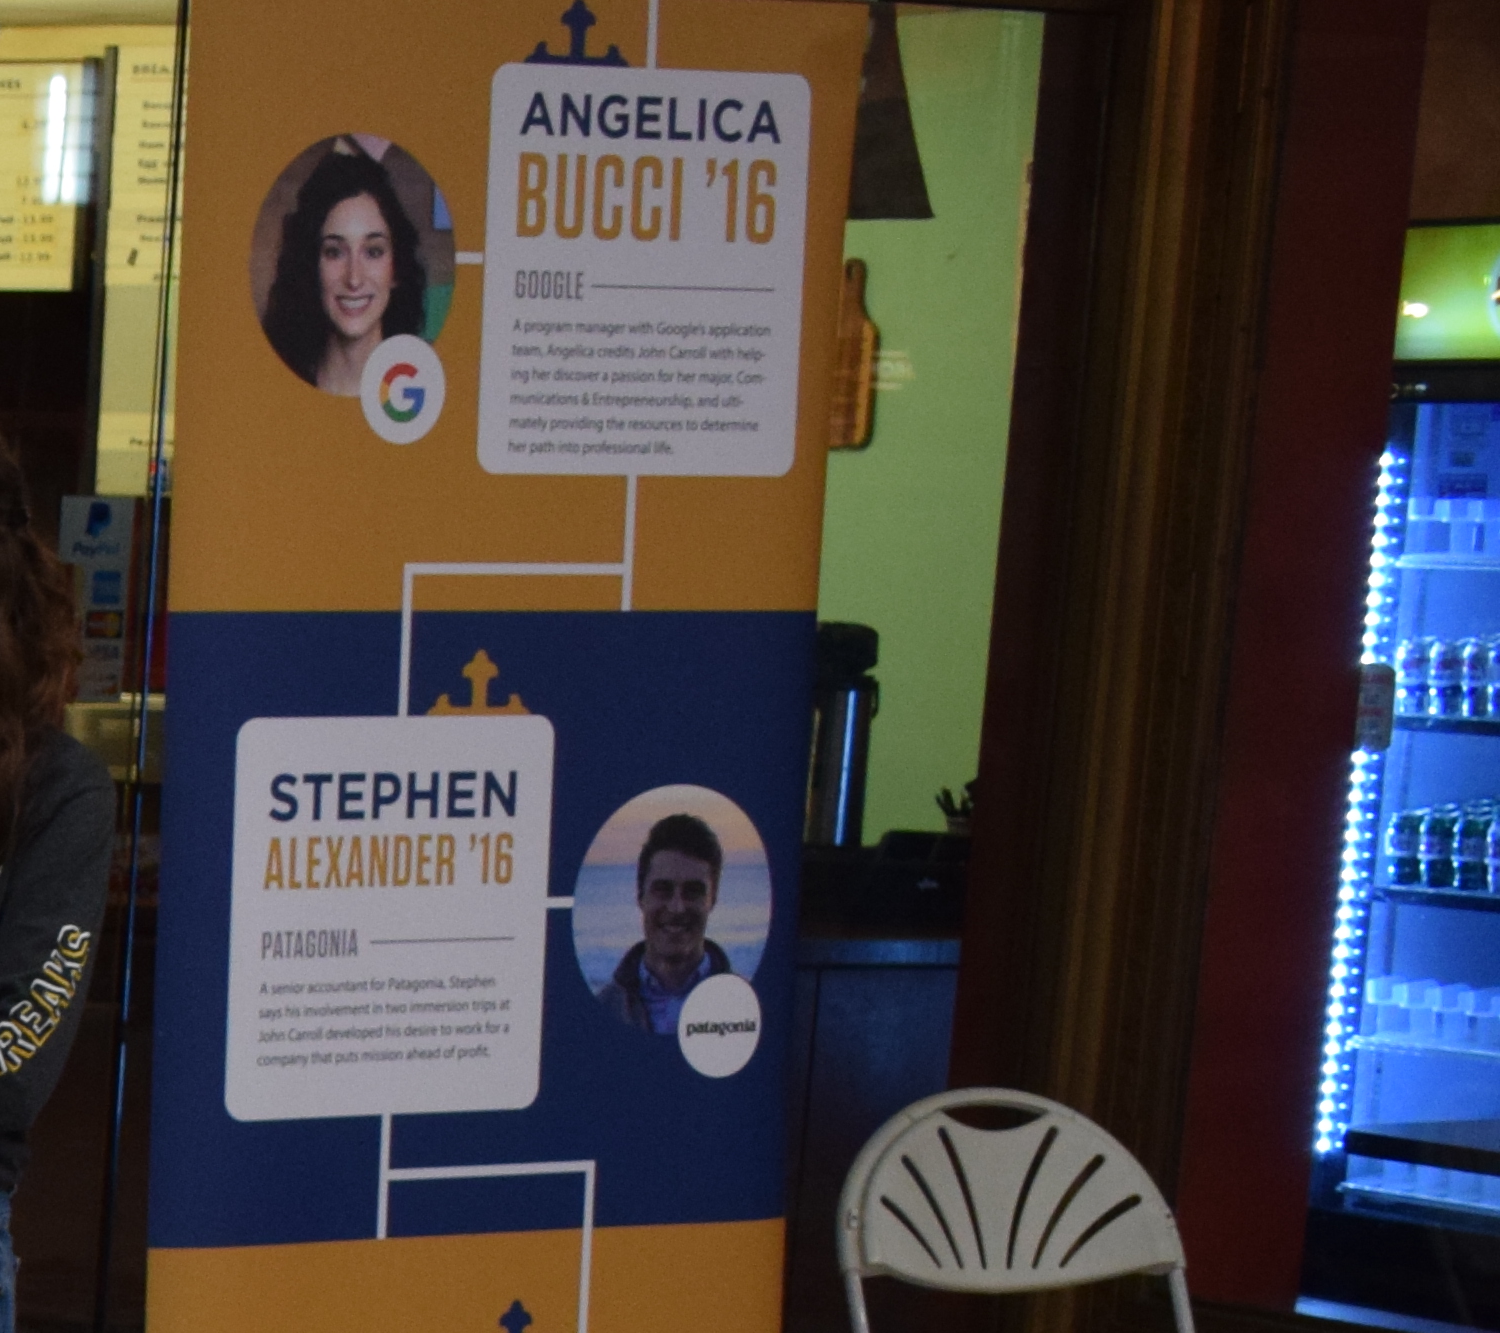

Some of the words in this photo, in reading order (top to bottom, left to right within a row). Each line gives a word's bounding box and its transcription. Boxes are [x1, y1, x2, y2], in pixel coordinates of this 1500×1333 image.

[520, 92, 781, 144] ANGELICA
[515, 152, 684, 242] BUCCI
[706, 157, 778, 245] '16
[515, 270, 585, 300] GOOGLE
[269, 770, 517, 821] STEPHEN
[263, 835, 455, 891] ALEXANDER
[469, 832, 514, 885] '16
[261, 929, 358, 960] PATAGONIA
[686, 1018, 757, 1038] patagonia
